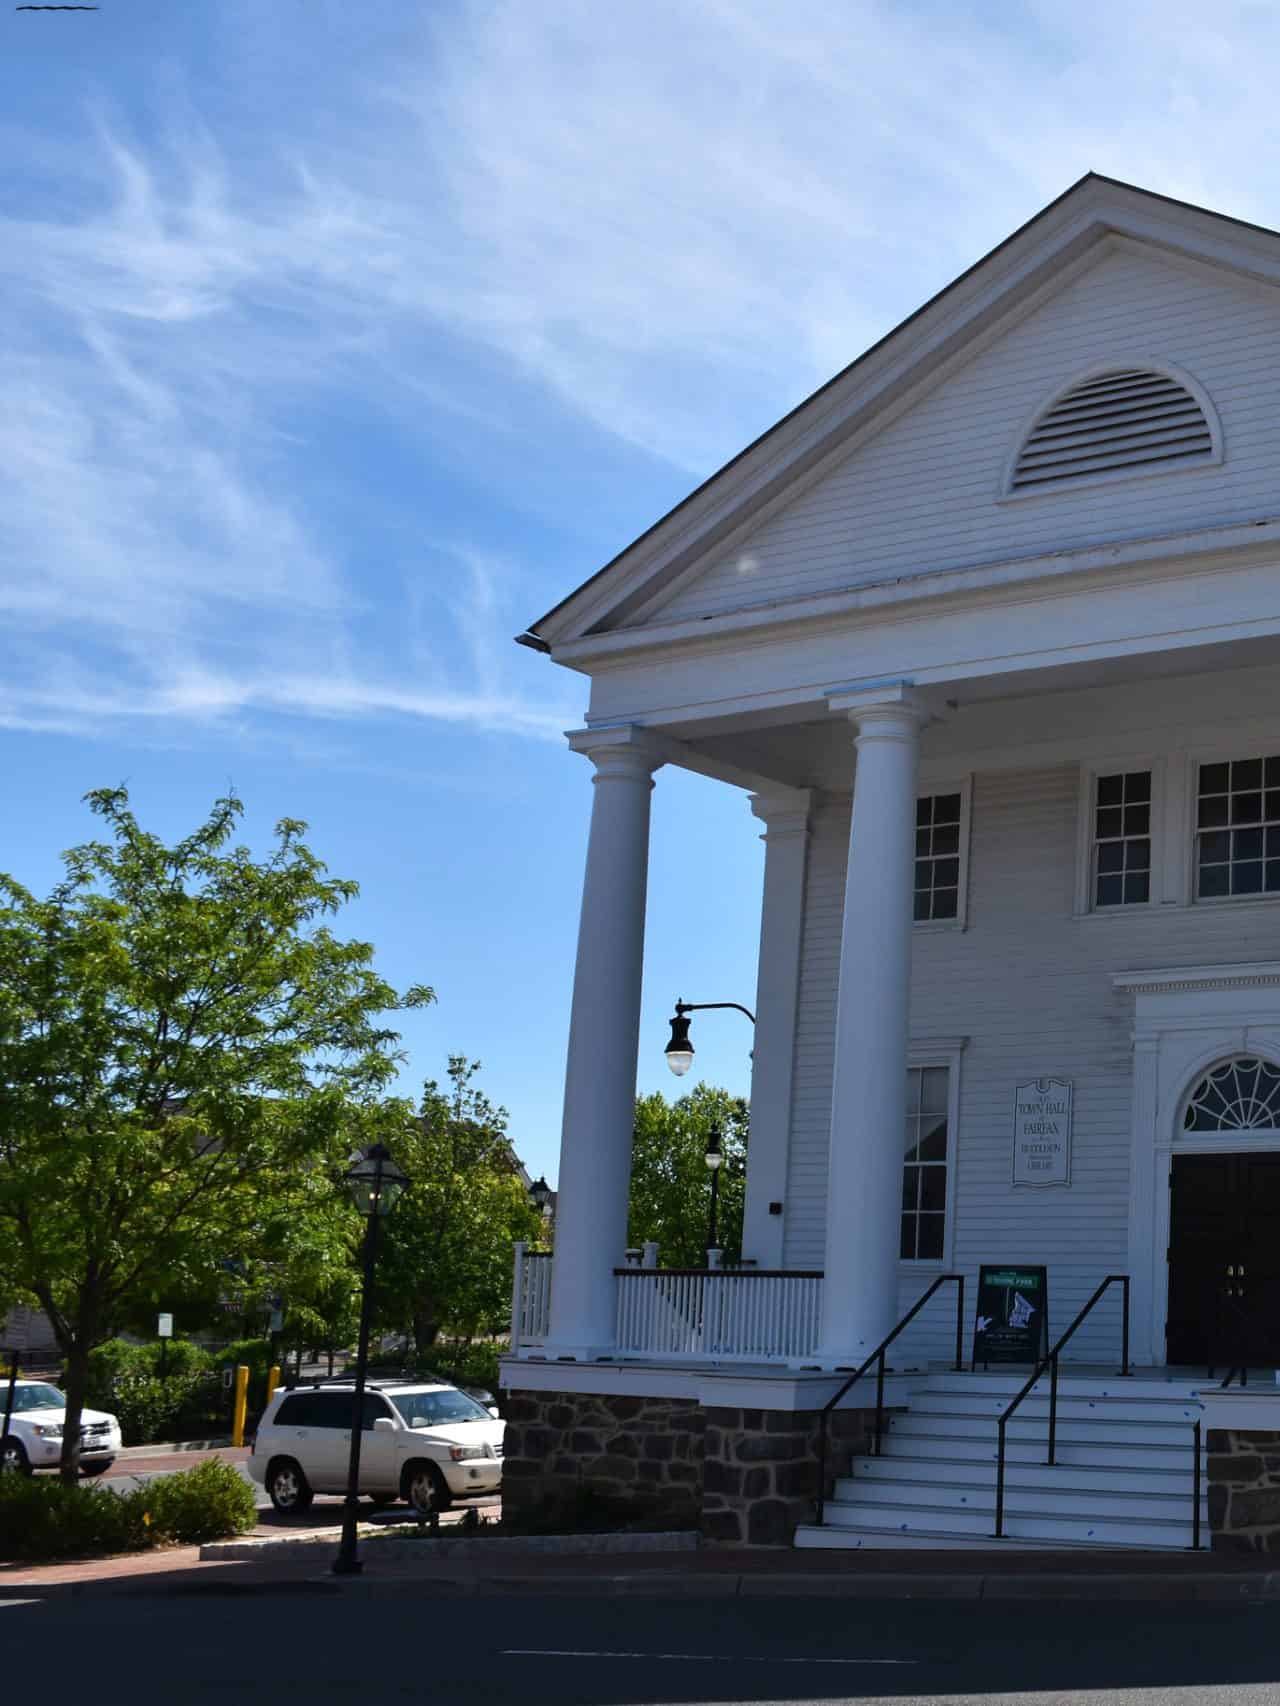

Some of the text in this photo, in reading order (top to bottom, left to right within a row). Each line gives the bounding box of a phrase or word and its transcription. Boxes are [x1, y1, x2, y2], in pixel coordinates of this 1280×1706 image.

[1018, 1102, 1065, 1114] TOWN HALL
[1023, 1122, 1058, 1135] FAIRFAX
